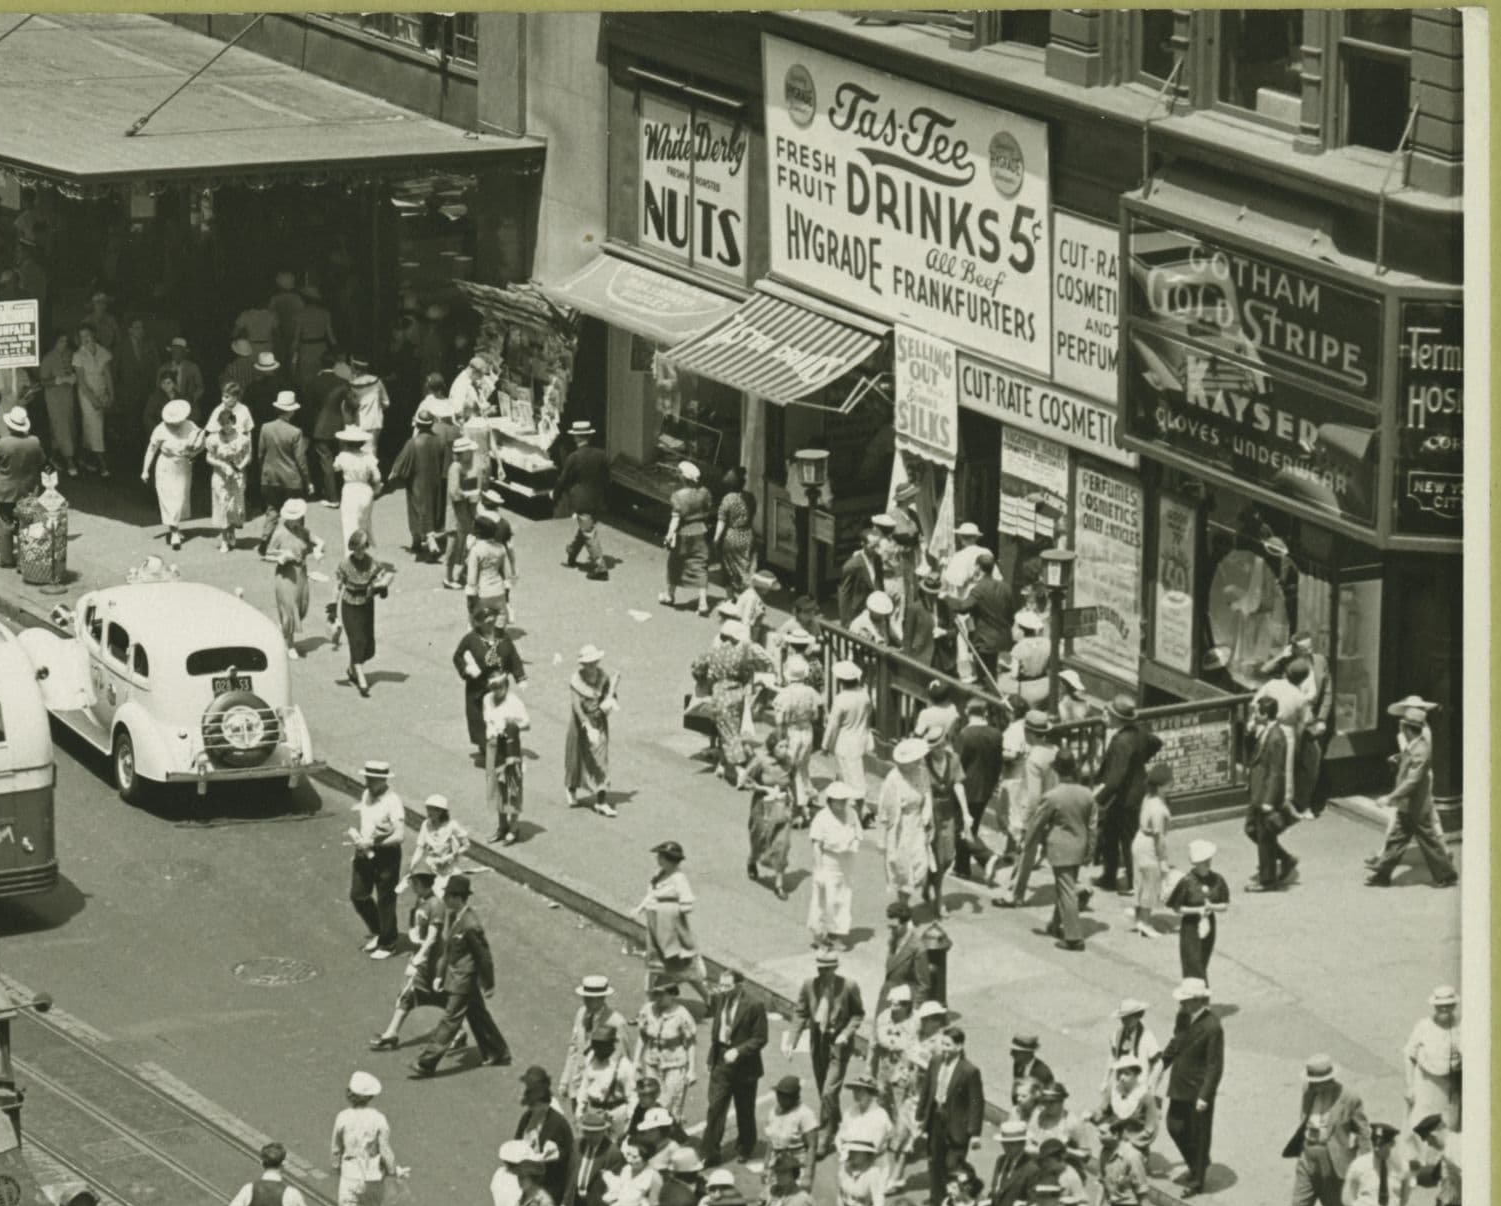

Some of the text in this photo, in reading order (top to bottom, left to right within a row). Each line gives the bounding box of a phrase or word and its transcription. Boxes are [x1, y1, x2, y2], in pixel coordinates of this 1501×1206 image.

[644, 121, 746, 177] White Derby
[776, 136, 836, 177] FRESH
[777, 165, 836, 205] FRUIT
[644, 180, 742, 268] NUTS
[846, 161, 1043, 274] DRINKS 5¢
[786, 203, 882, 295] HYGRADE
[1059, 238, 1119, 281] CUT-RA
[960, 256, 1006, 298] Beef
[1190, 245, 1321, 313] GOTHAM
[893, 265, 1036, 343] FRANKFURTERS
[1085, 317, 1112, 339] AND
[1244, 299, 1368, 374] STRIPE
[898, 334, 951, 380] SELLING
[909, 360, 940, 387] OUT
[899, 400, 950, 447] SILKS
[1186, 356, 1320, 450] KAYSER
[1155, 406, 1348, 495] GLOVES UNDERWEAR
[1082, 471, 1137, 507] PERFUMES
[1414, 481, 1445, 494] NEW
